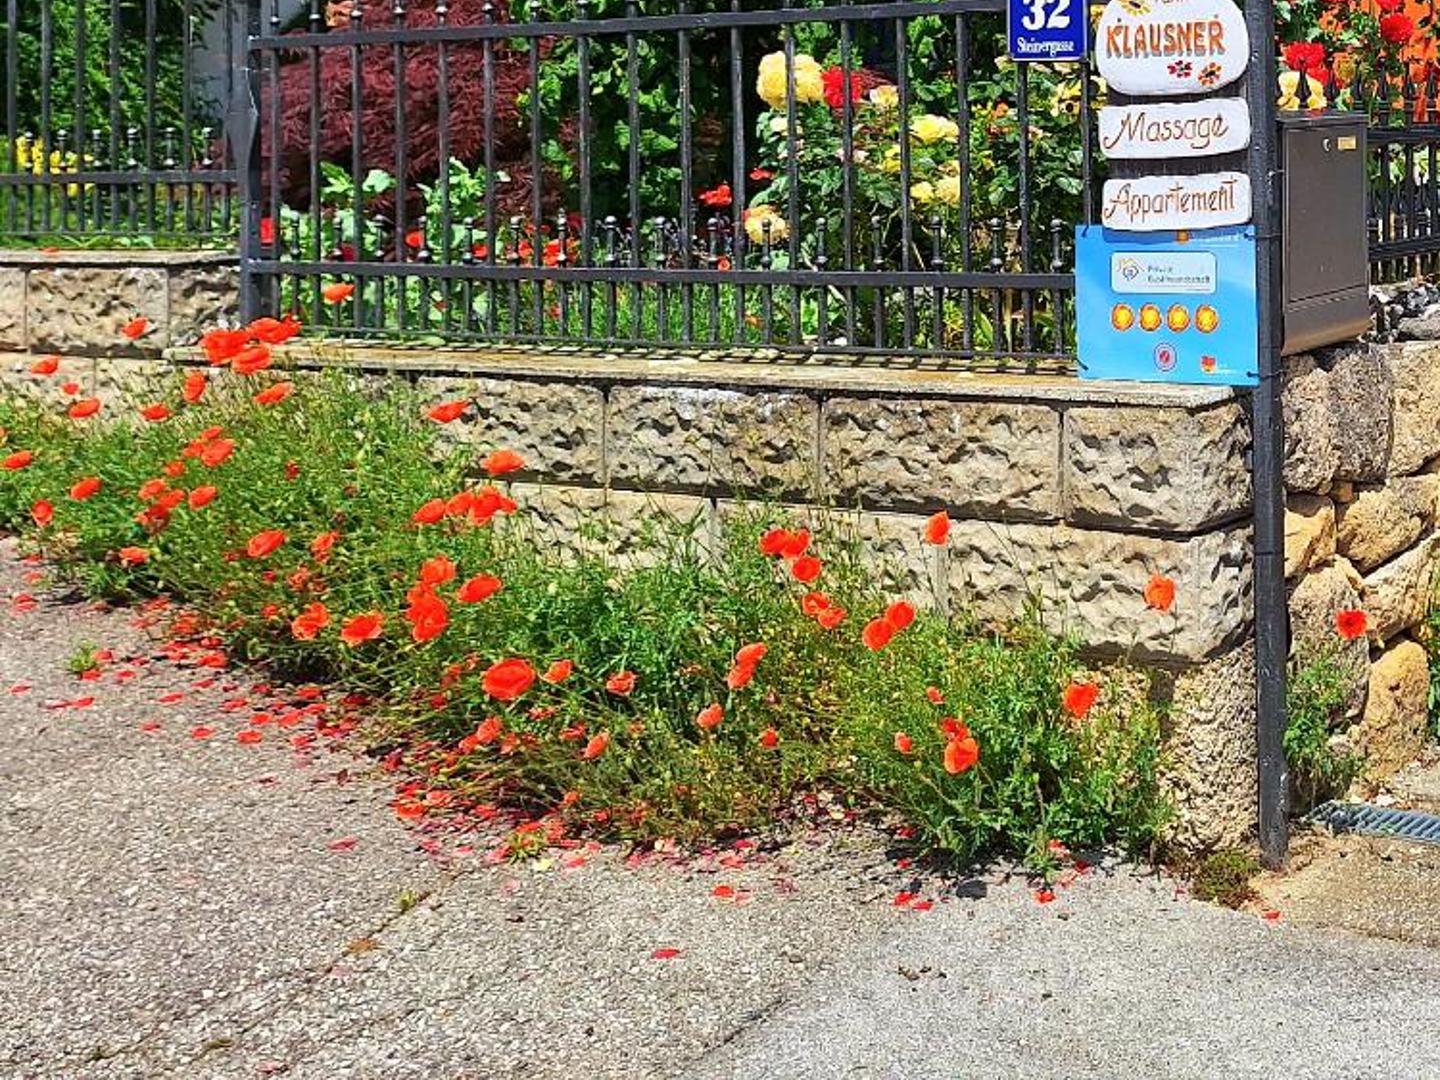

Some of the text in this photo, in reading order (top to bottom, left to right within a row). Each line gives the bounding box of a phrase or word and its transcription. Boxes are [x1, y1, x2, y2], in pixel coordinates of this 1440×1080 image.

[1106, 20, 1225, 59] KLAUSNER
[1103, 111, 1229, 149] Massage
[1104, 177, 1237, 223] Appartement
